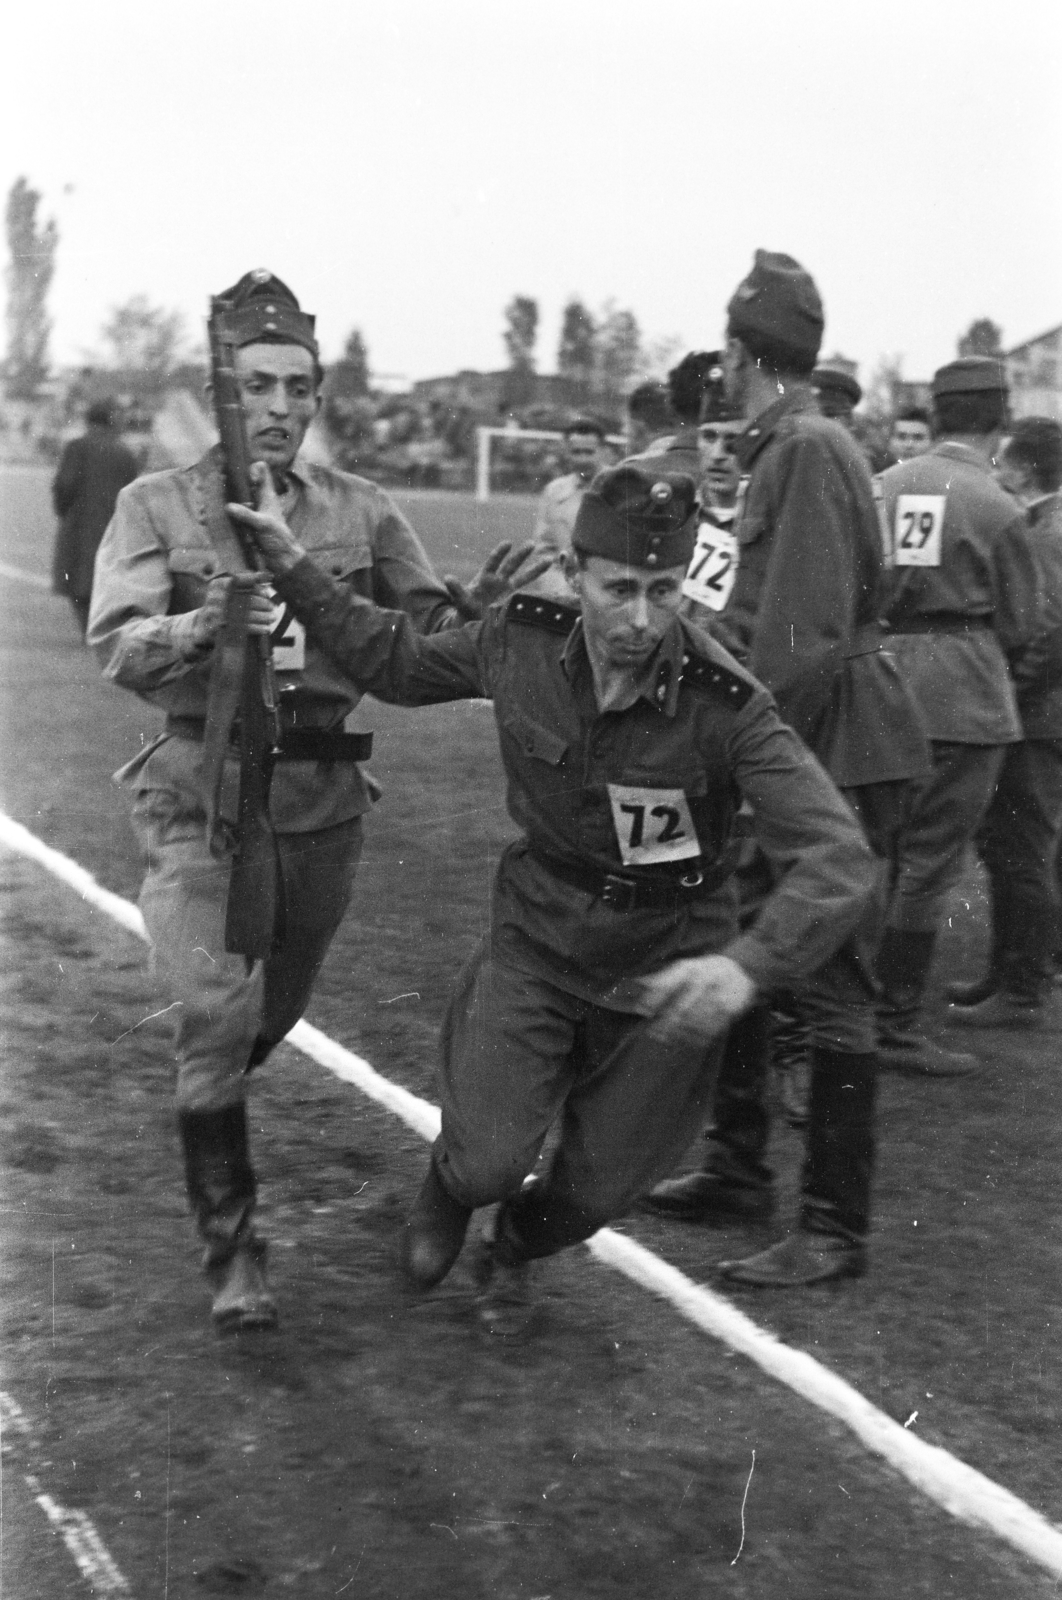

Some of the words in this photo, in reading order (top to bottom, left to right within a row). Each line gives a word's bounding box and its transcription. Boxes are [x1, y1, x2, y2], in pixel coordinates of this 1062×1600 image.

[901, 511, 934, 549] 29
[689, 542, 731, 592] 72
[620, 804, 686, 848] 72
